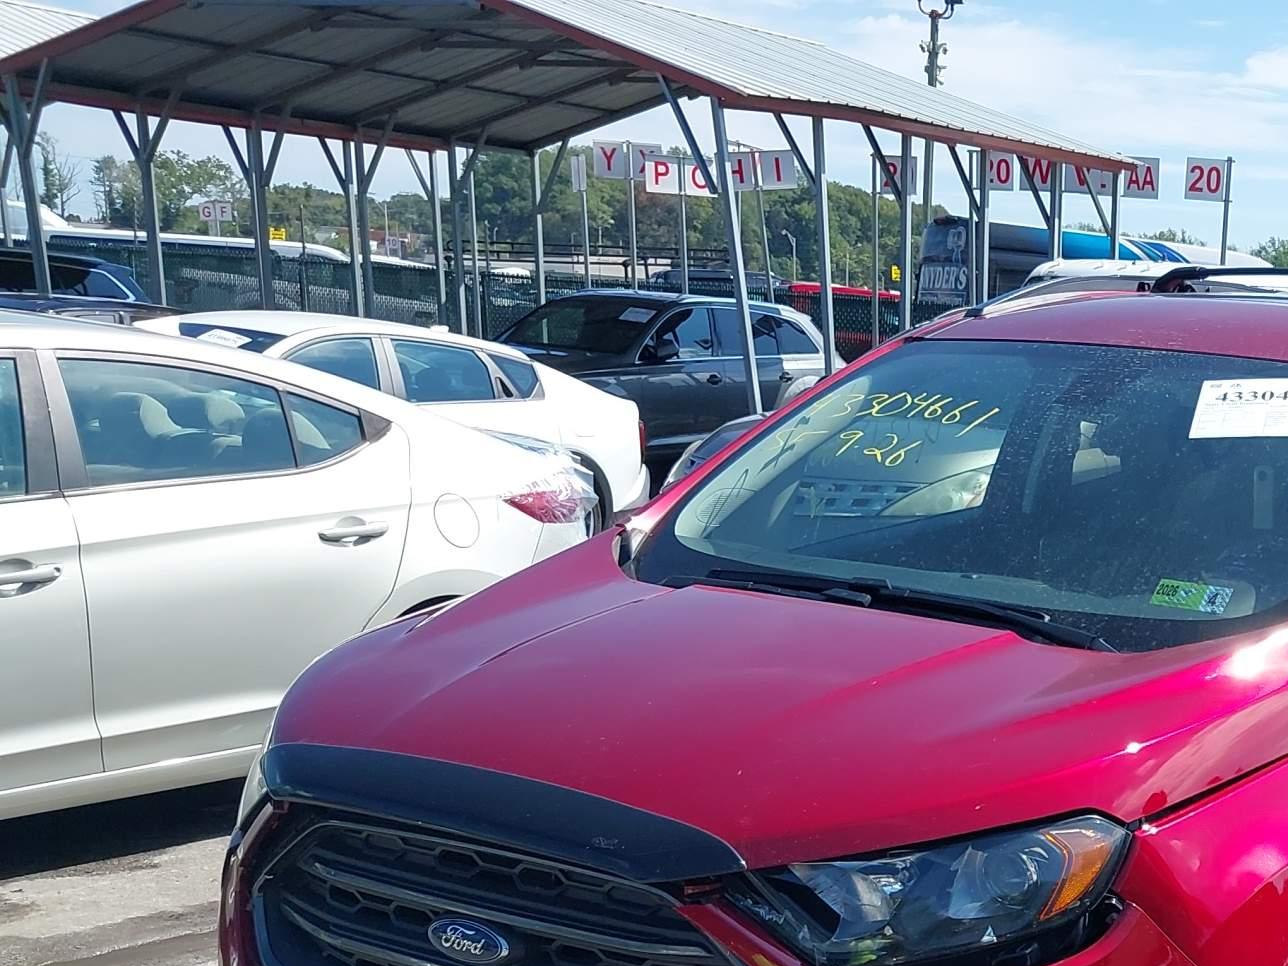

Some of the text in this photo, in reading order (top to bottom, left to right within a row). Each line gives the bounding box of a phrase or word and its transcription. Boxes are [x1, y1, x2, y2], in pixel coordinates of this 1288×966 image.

[600, 147, 616, 171] Y
[654, 161, 669, 185] P
[1127, 166, 1155, 191] AA
[1189, 165, 1221, 193] 20
[202, 206, 227, 218] G F
[918, 265, 968, 290] NYDER'S
[440, 925, 486, 955] Ford
